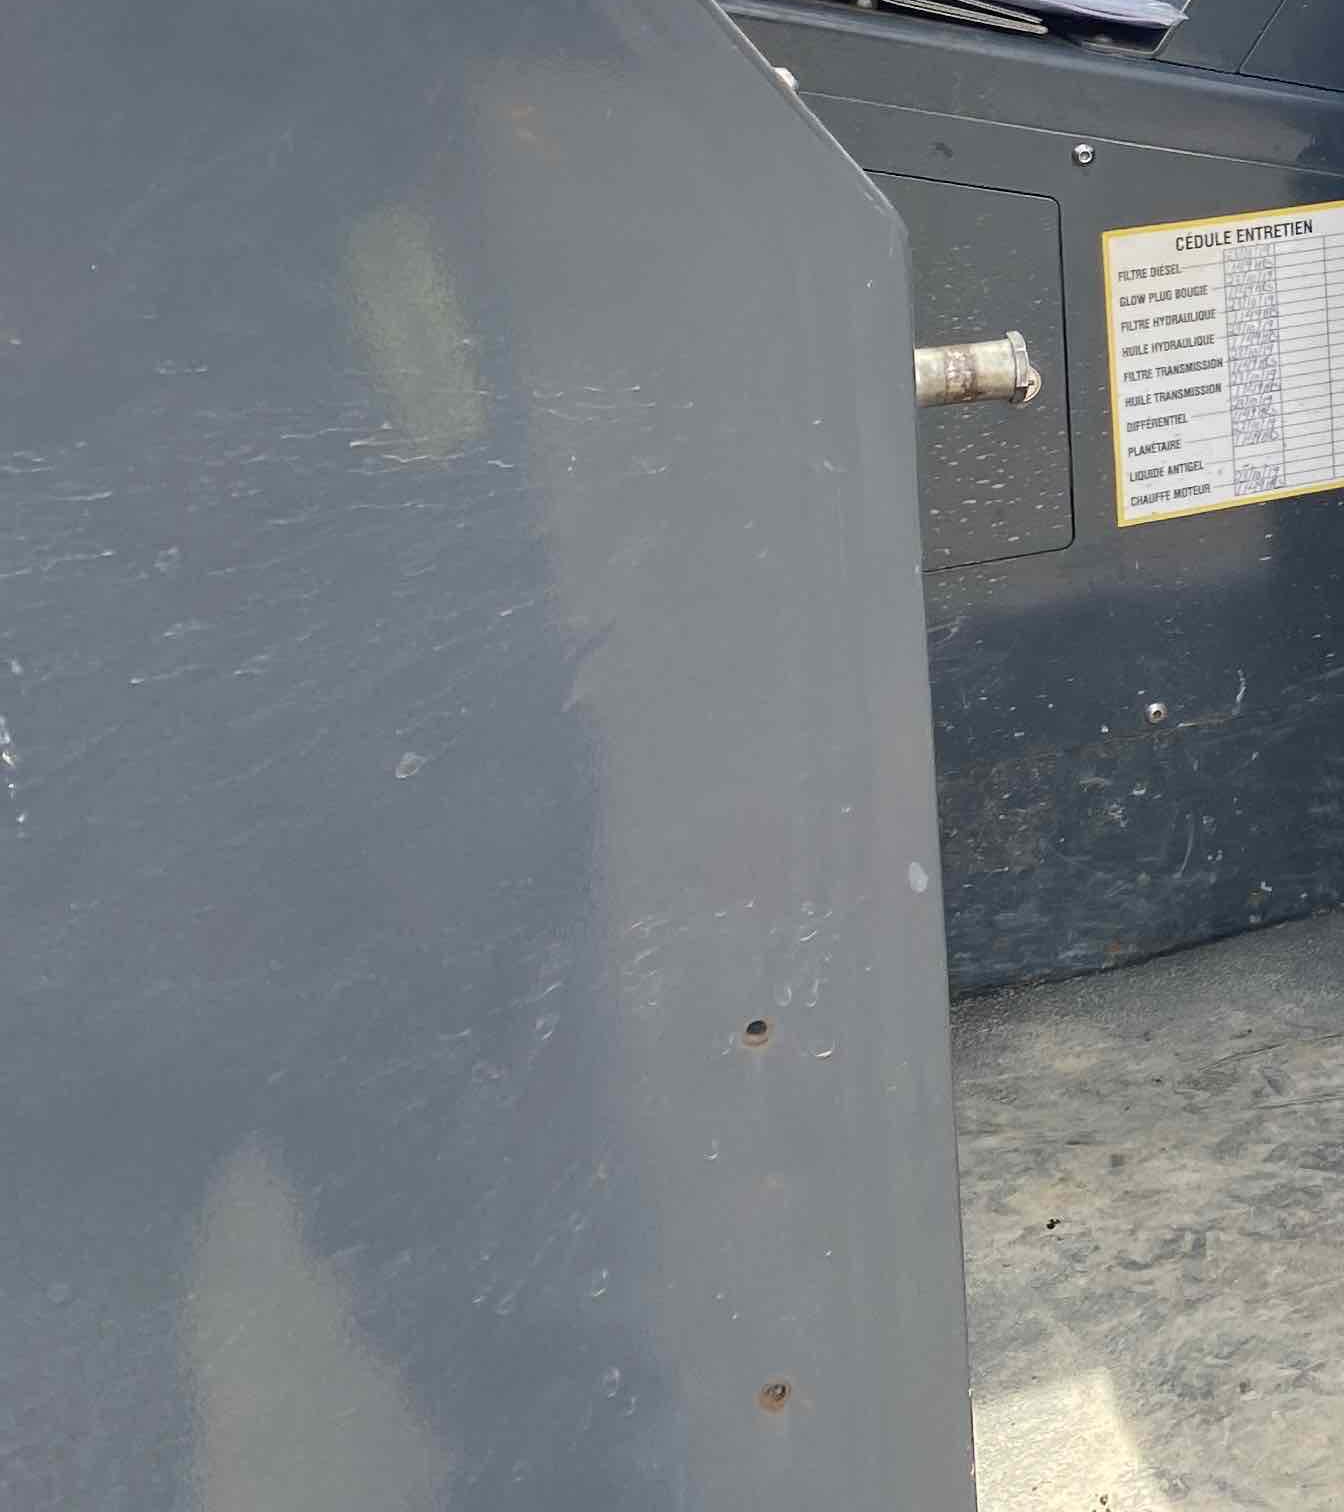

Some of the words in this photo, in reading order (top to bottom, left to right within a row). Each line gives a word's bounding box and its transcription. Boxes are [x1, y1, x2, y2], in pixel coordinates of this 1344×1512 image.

[1175, 228, 1232, 252] CÉDULE
[1236, 219, 1313, 244] ENTRETIEN
[1118, 268, 1147, 282] FILTRE
[1119, 294, 1146, 308] GLOW
[1149, 289, 1173, 304] PLUG
[1175, 284, 1208, 299] BOUGIE
[1120, 319, 1150, 333] FILTRE
[1153, 308, 1217, 328] HYDRAULIQUE
[1121, 343, 1149, 358] HUILE
[1151, 334, 1215, 354] HYDRAULIQUE
[1123, 368, 1153, 382] FILTRE
[1155, 357, 1223, 377] TRANSMISSION
[1125, 394, 1152, 408] HUILE
[1154, 382, 1222, 403] TRANSMISSION
[1129, 468, 1165, 482] LIQUIDE
[1167, 460, 1205, 476] ANTIGEL
[1131, 490, 1171, 506] CHAUFFE
[1174, 483, 1211, 498] MOTEUR
